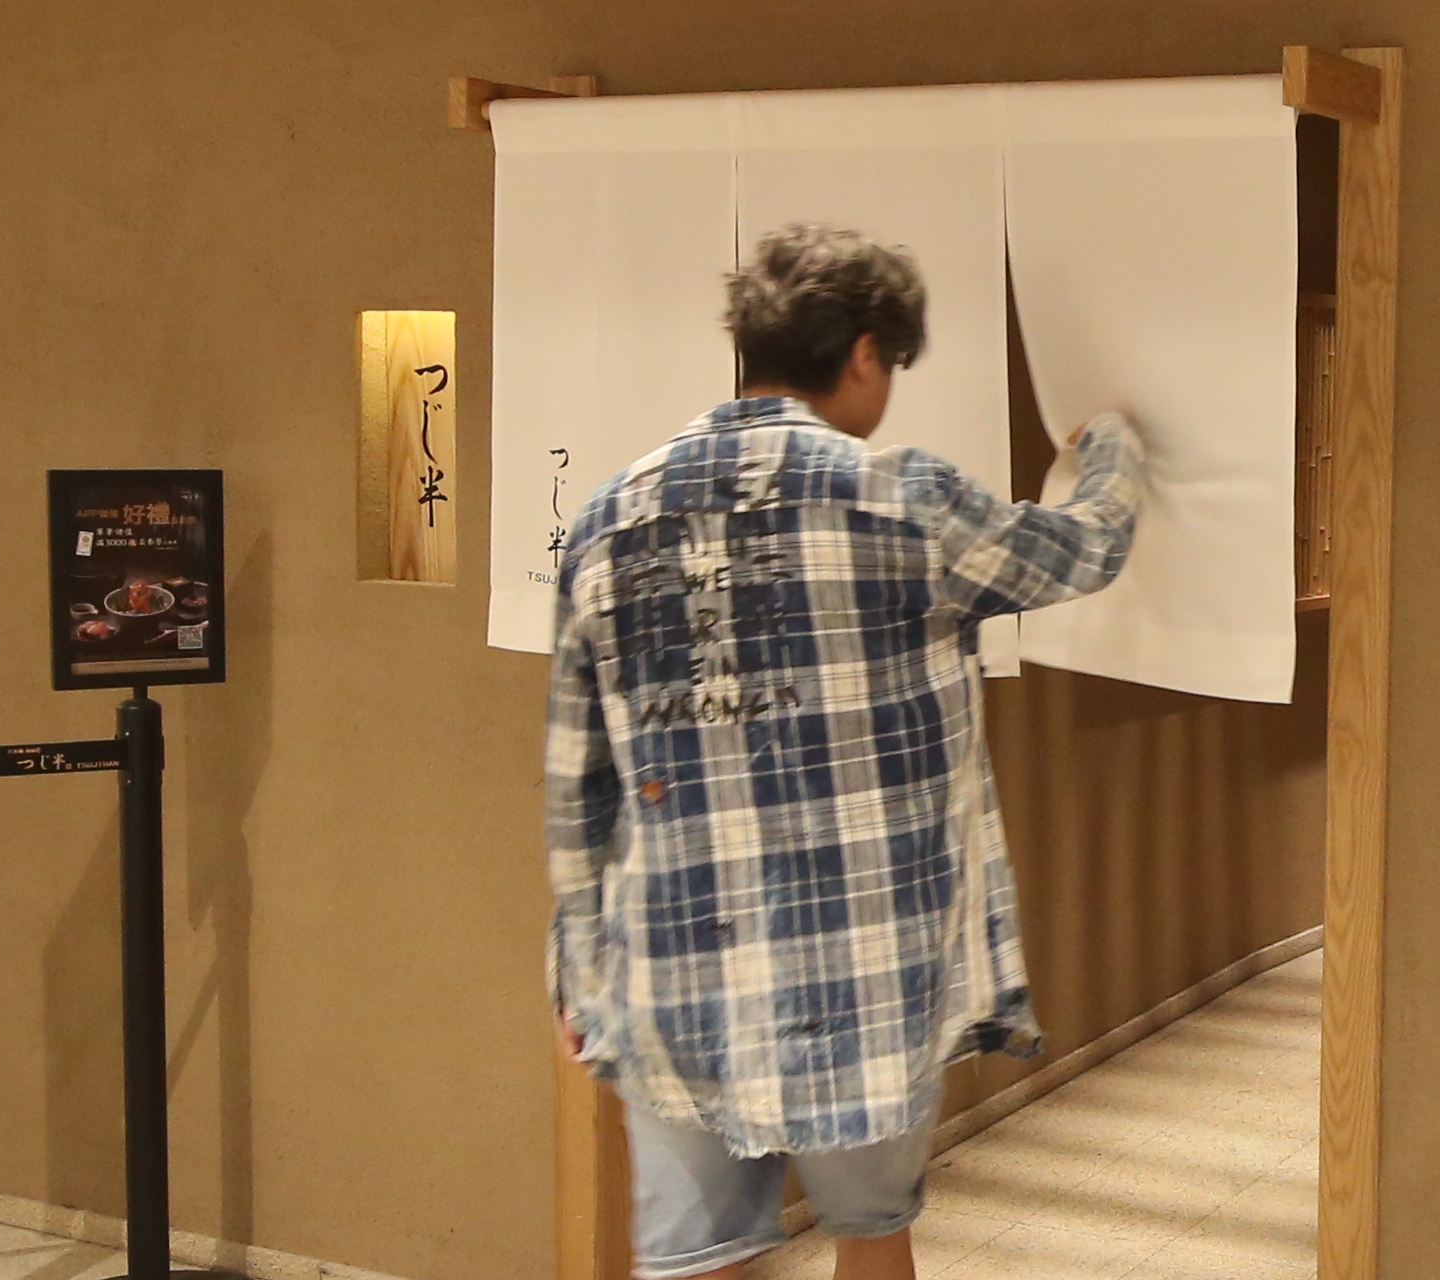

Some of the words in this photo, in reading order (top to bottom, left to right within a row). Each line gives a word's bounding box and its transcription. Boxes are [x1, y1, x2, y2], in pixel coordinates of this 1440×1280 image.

[414, 364, 449, 528] つじ半
[547, 448, 569, 569] つじ半
[16, 753, 66, 770] つじ半
